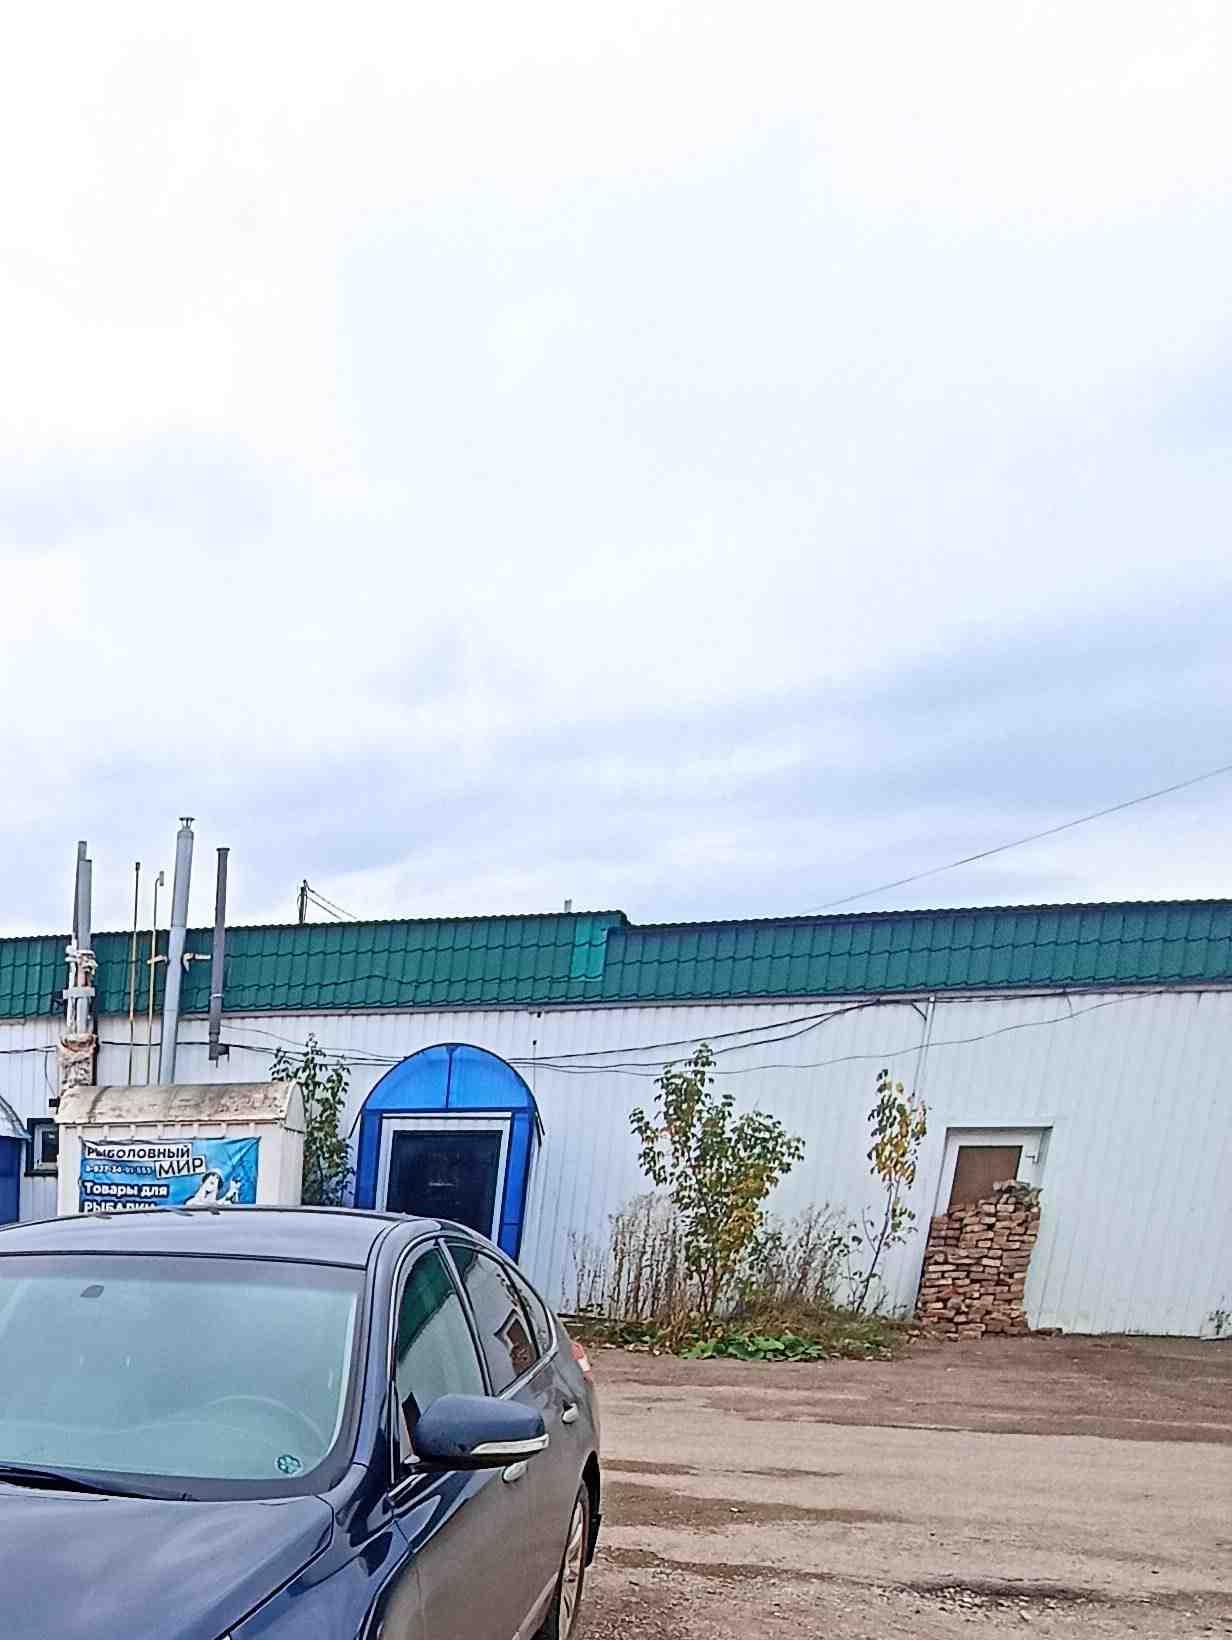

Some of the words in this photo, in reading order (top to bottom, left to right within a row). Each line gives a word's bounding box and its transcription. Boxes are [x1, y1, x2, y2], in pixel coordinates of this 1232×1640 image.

[158, 1158, 203, 1177] МИР
[85, 1182, 137, 1197] Товары
[141, 1185, 167, 1197] для
